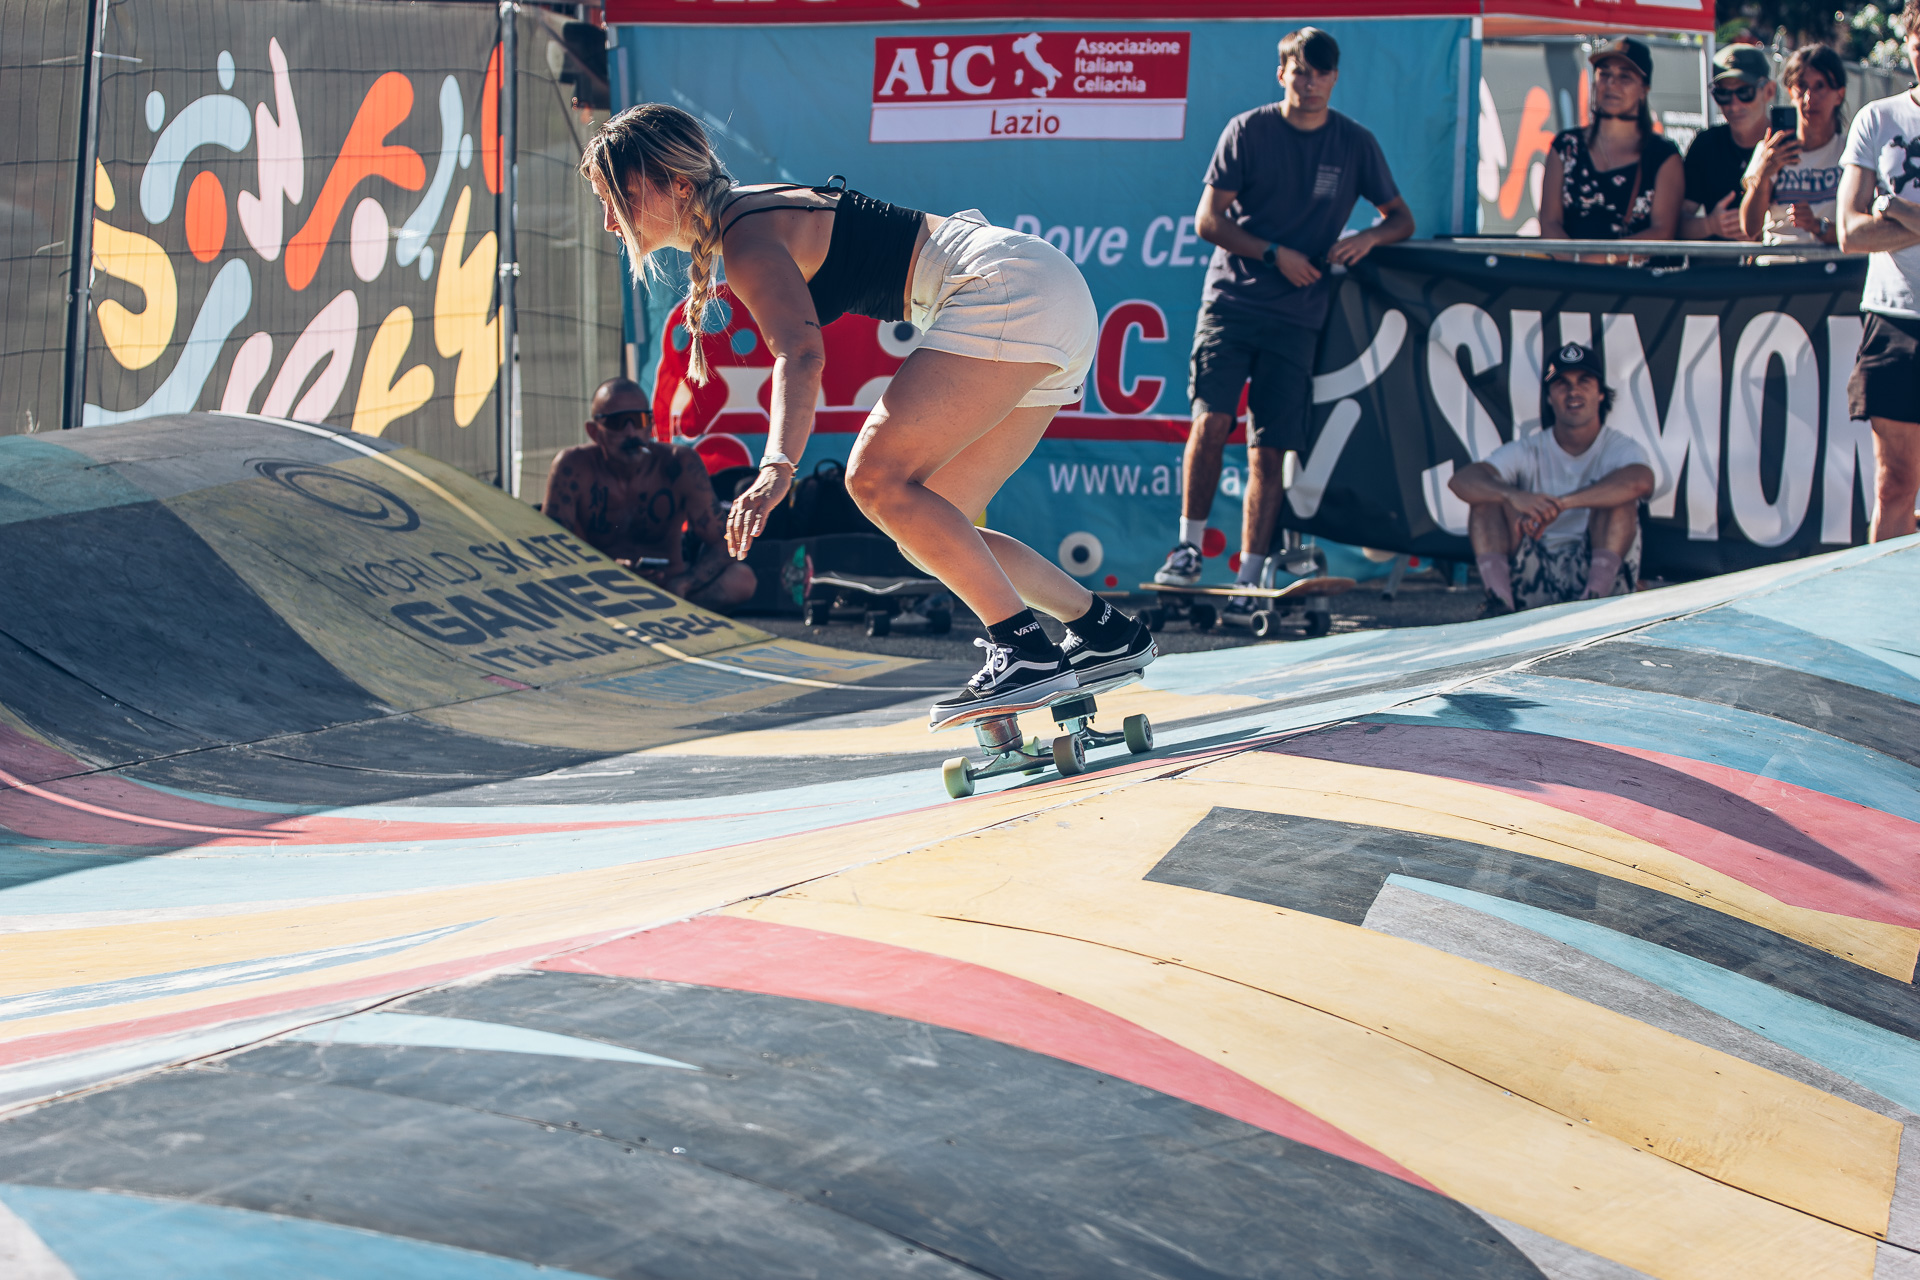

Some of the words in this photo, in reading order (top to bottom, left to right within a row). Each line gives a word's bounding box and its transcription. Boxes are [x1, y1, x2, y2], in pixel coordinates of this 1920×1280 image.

[1074, 38, 1181, 55] Associazione
[877, 42, 996, 96] AiC
[1074, 57, 1134, 74] Italiana
[1073, 75, 1147, 93] Celiachia
[990, 109, 1061, 136] Lazio
[321, 551, 483, 598] WORLD
[468, 532, 603, 575] SKATE
[389, 568, 678, 645] GAMES
[1098, 602, 1113, 626] VANS
[1013, 621, 1040, 637] VANS
[469, 632, 638, 673] ITALIA
[610, 612, 735, 647] 2024
